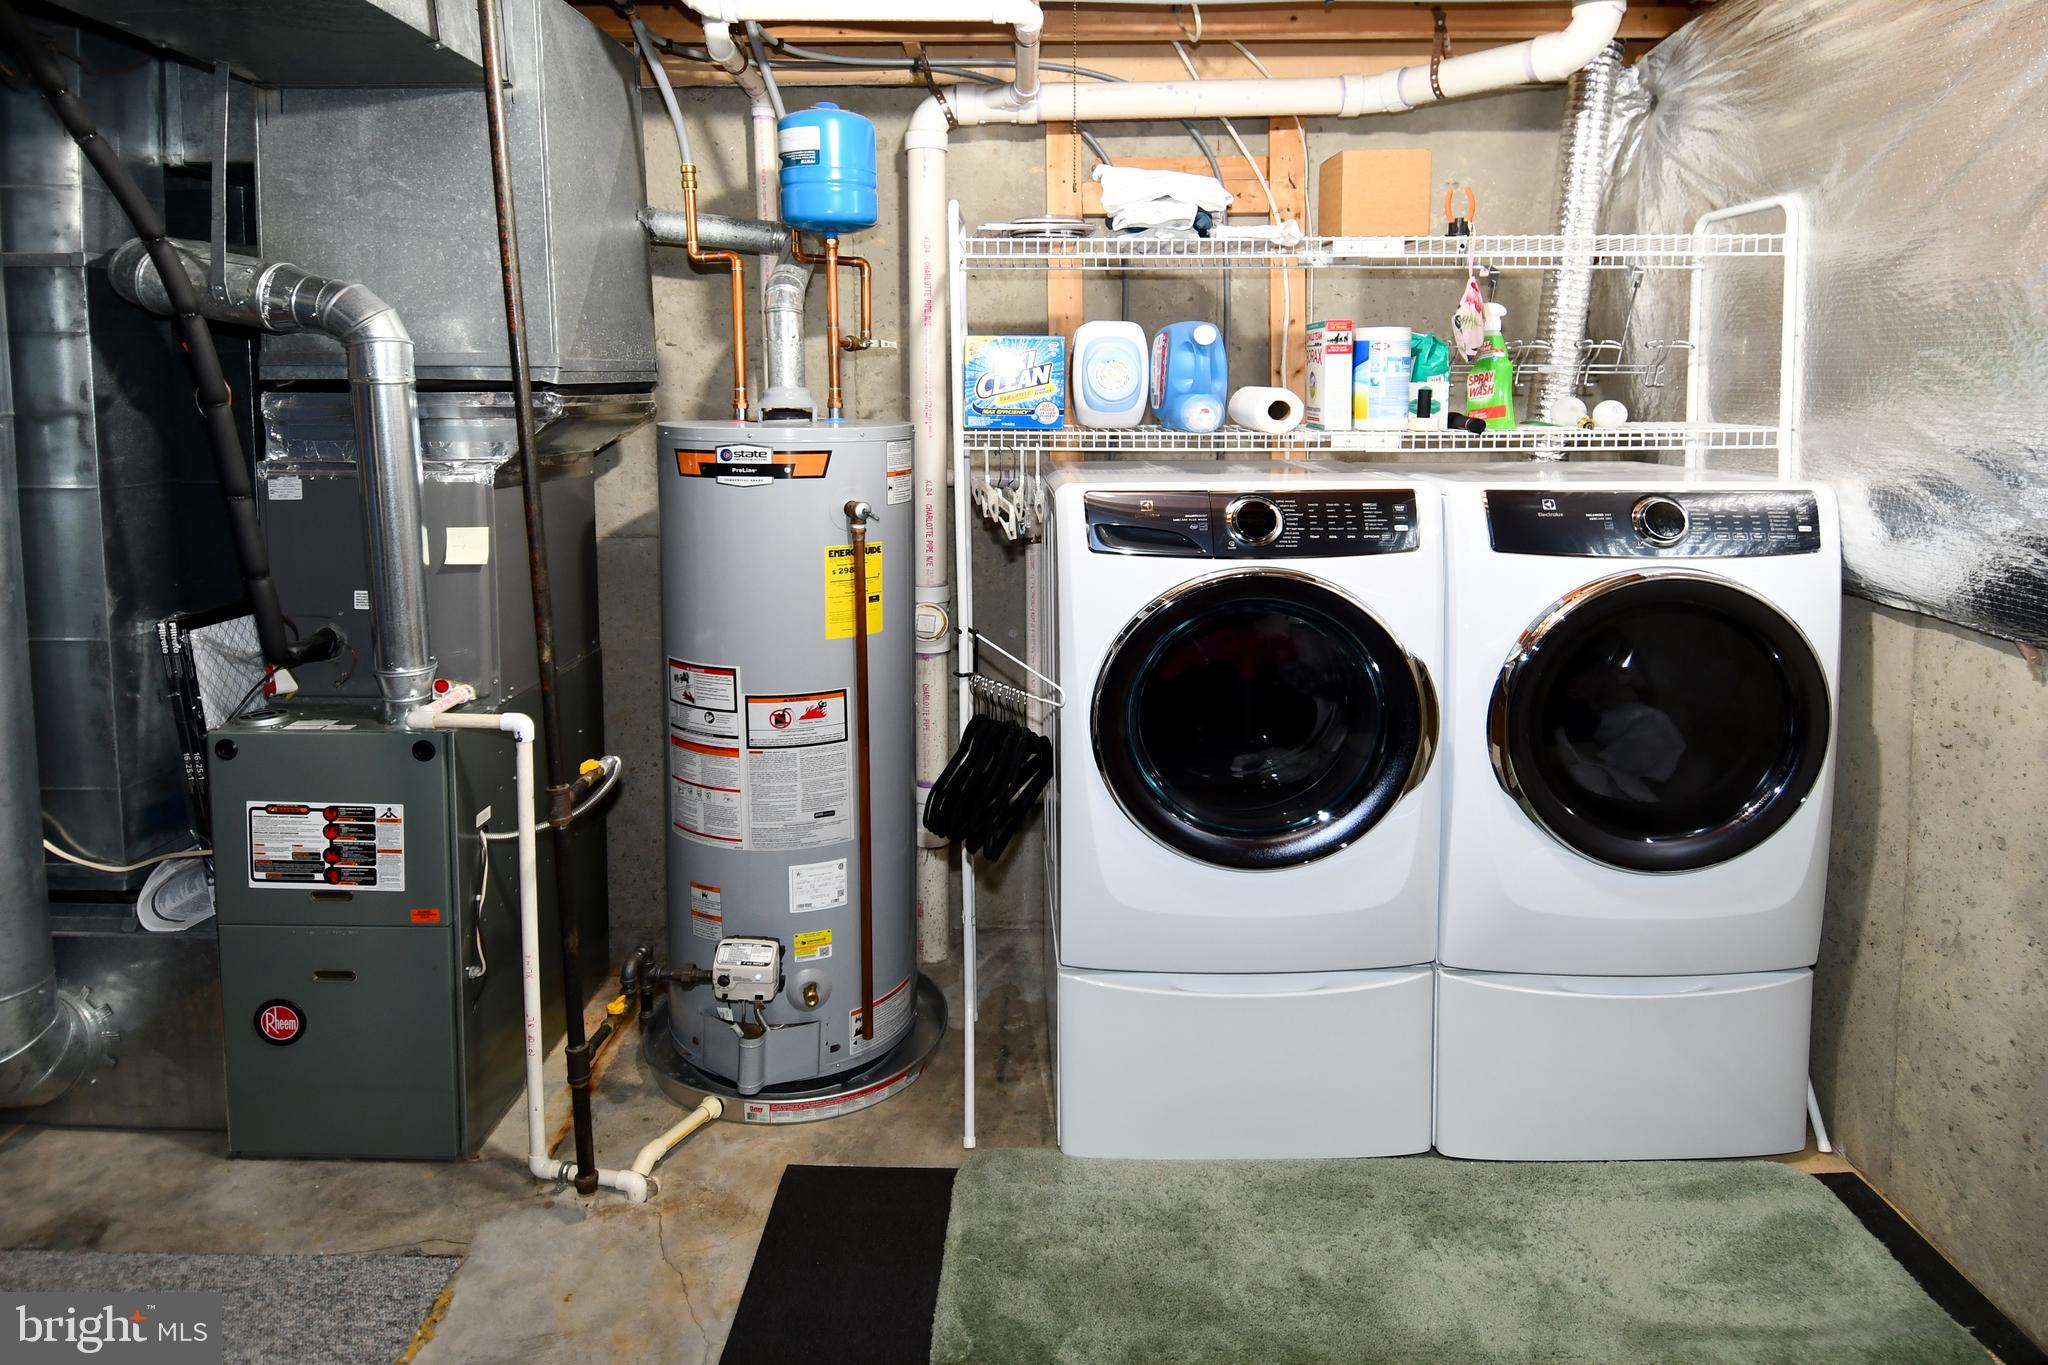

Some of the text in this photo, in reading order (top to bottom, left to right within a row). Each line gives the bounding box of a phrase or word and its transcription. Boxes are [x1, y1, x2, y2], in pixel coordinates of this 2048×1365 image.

[976, 362, 1053, 399] CLEAN
[1468, 372, 1494, 386] SPRAY
[1469, 385, 1494, 398] WASH
[734, 450, 767, 458] state
[925, 503, 933, 538] CHARLOTTE
[925, 540, 934, 553] PIPE
[266, 1007, 297, 1034] Rheem
